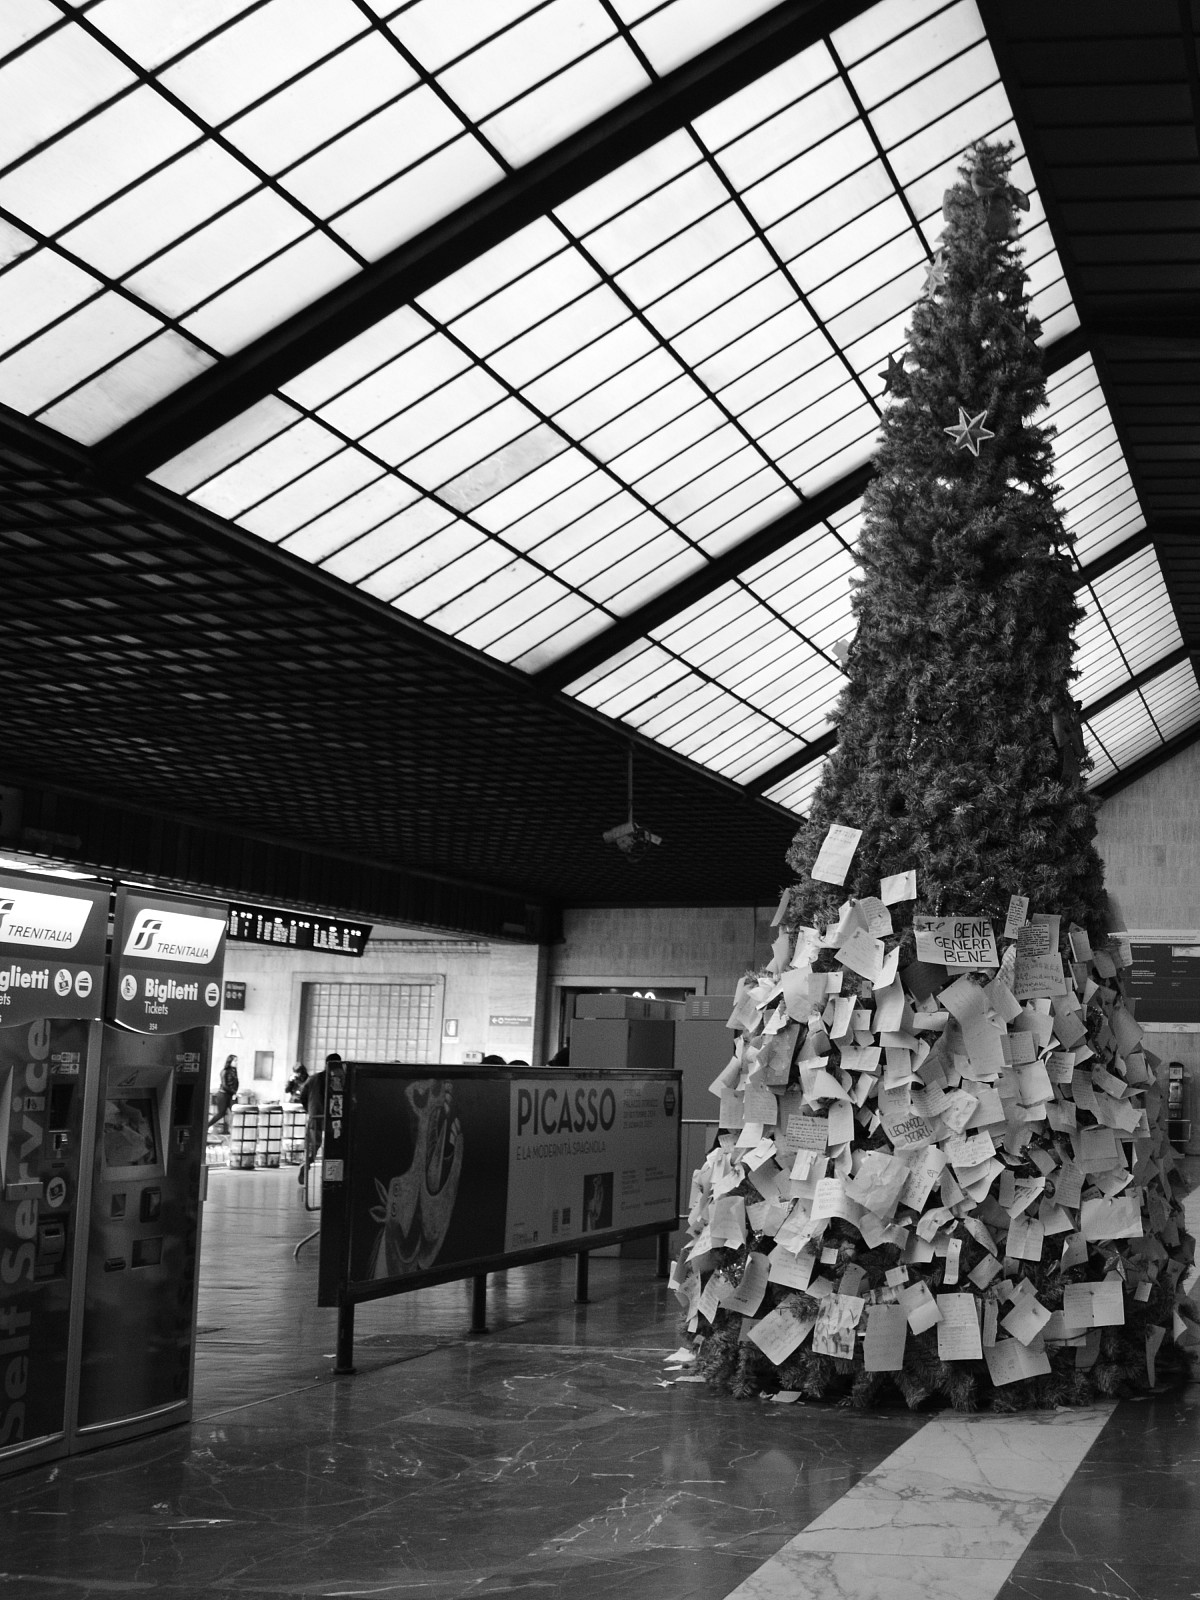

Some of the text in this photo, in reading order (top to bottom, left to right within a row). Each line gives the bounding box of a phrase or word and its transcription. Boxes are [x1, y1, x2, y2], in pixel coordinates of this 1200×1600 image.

[8, 925, 73, 942] TRENITALIA
[953, 921, 992, 939] BENE
[157, 943, 209, 958] TRENITALIA
[934, 936, 992, 950] GENERA
[944, 949, 992, 963] BENE
[145, 978, 199, 1003] Biglietti
[144, 1001, 169, 1015] Tickets
[517, 1087, 617, 1136] PICASSO
